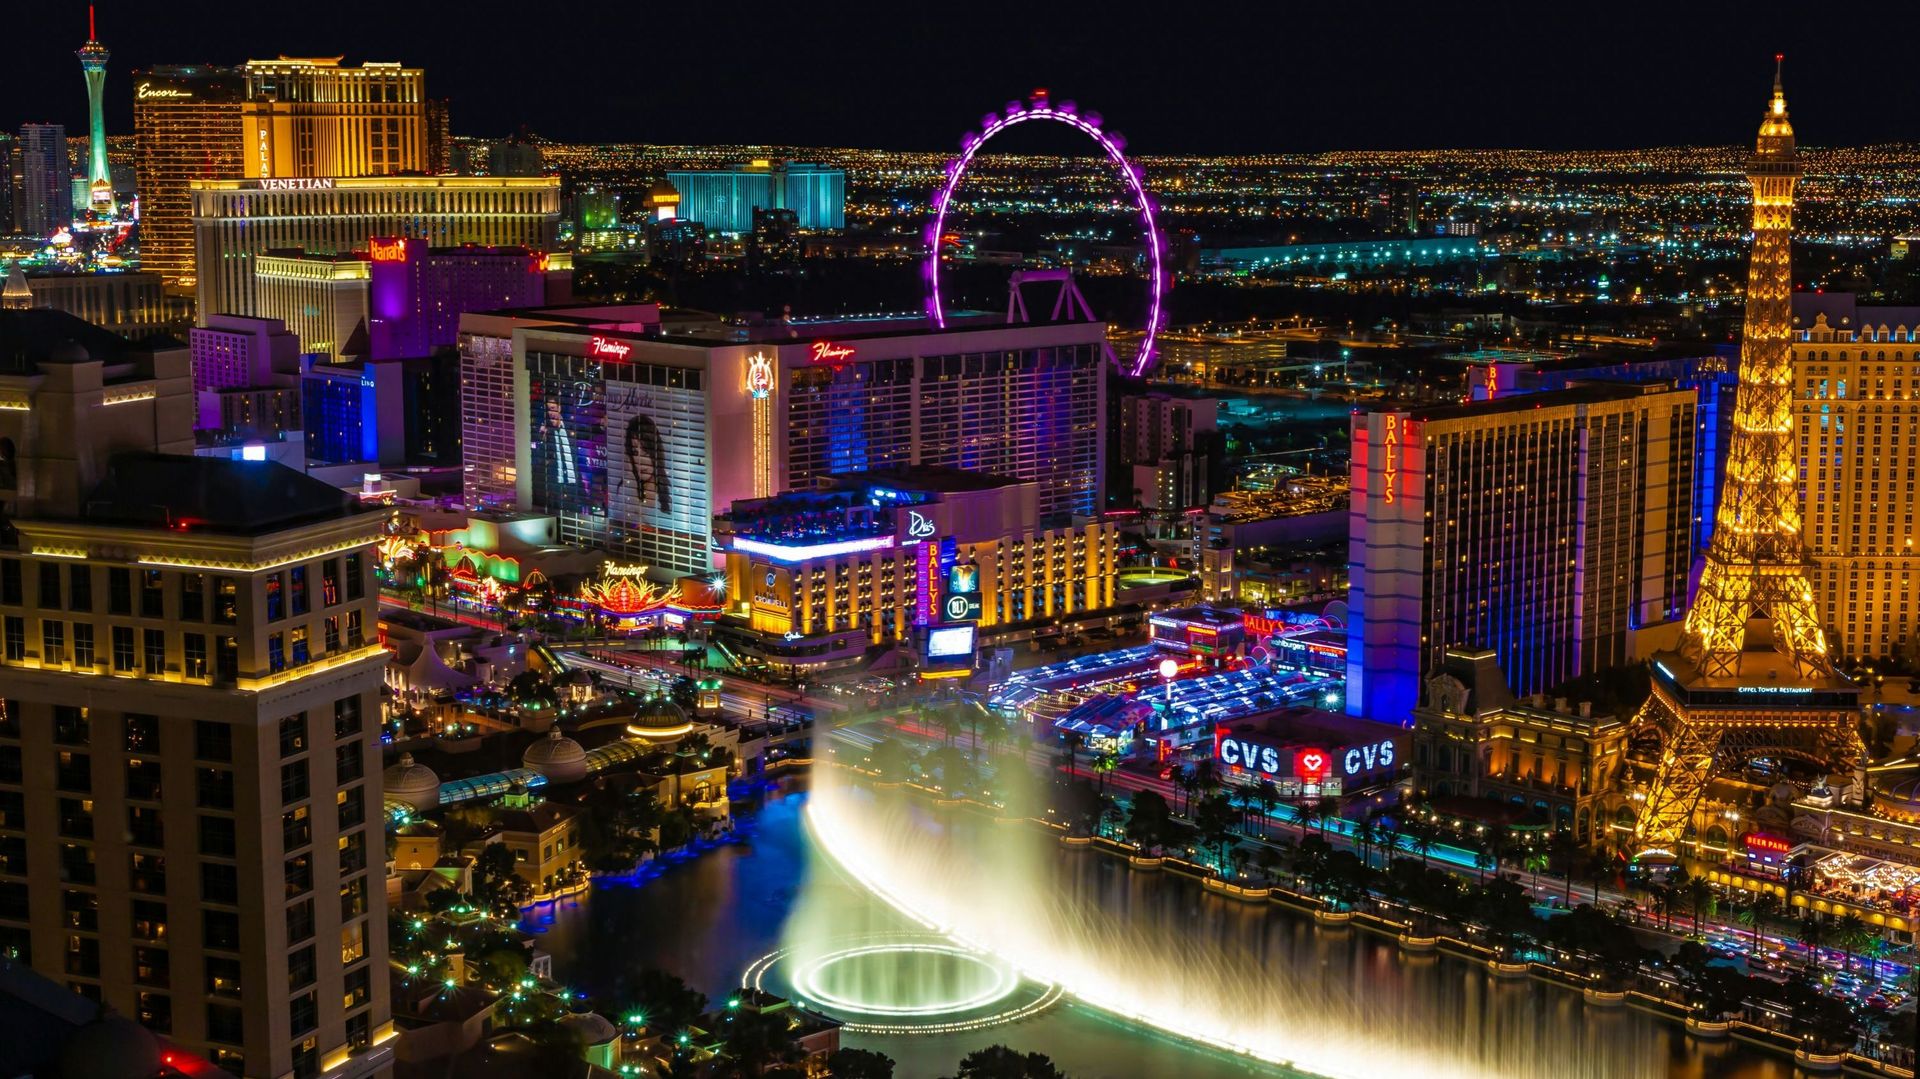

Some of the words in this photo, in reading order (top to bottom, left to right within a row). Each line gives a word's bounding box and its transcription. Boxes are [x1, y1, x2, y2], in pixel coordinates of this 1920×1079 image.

[138, 82, 192, 99] Encore
[260, 178, 332, 189] VENETIAN
[593, 337, 630, 358] Flamingo
[812, 342, 855, 361] Flamingo
[604, 560, 649, 579] Flamingo
[951, 600, 964, 614] BLT
[1244, 614, 1285, 634] BALLY'S
[1221, 738, 1279, 774] CVS
[1345, 740, 1394, 775] CVS
[1747, 836, 1767, 848] BEER
[1768, 840, 1789, 852] PARK
